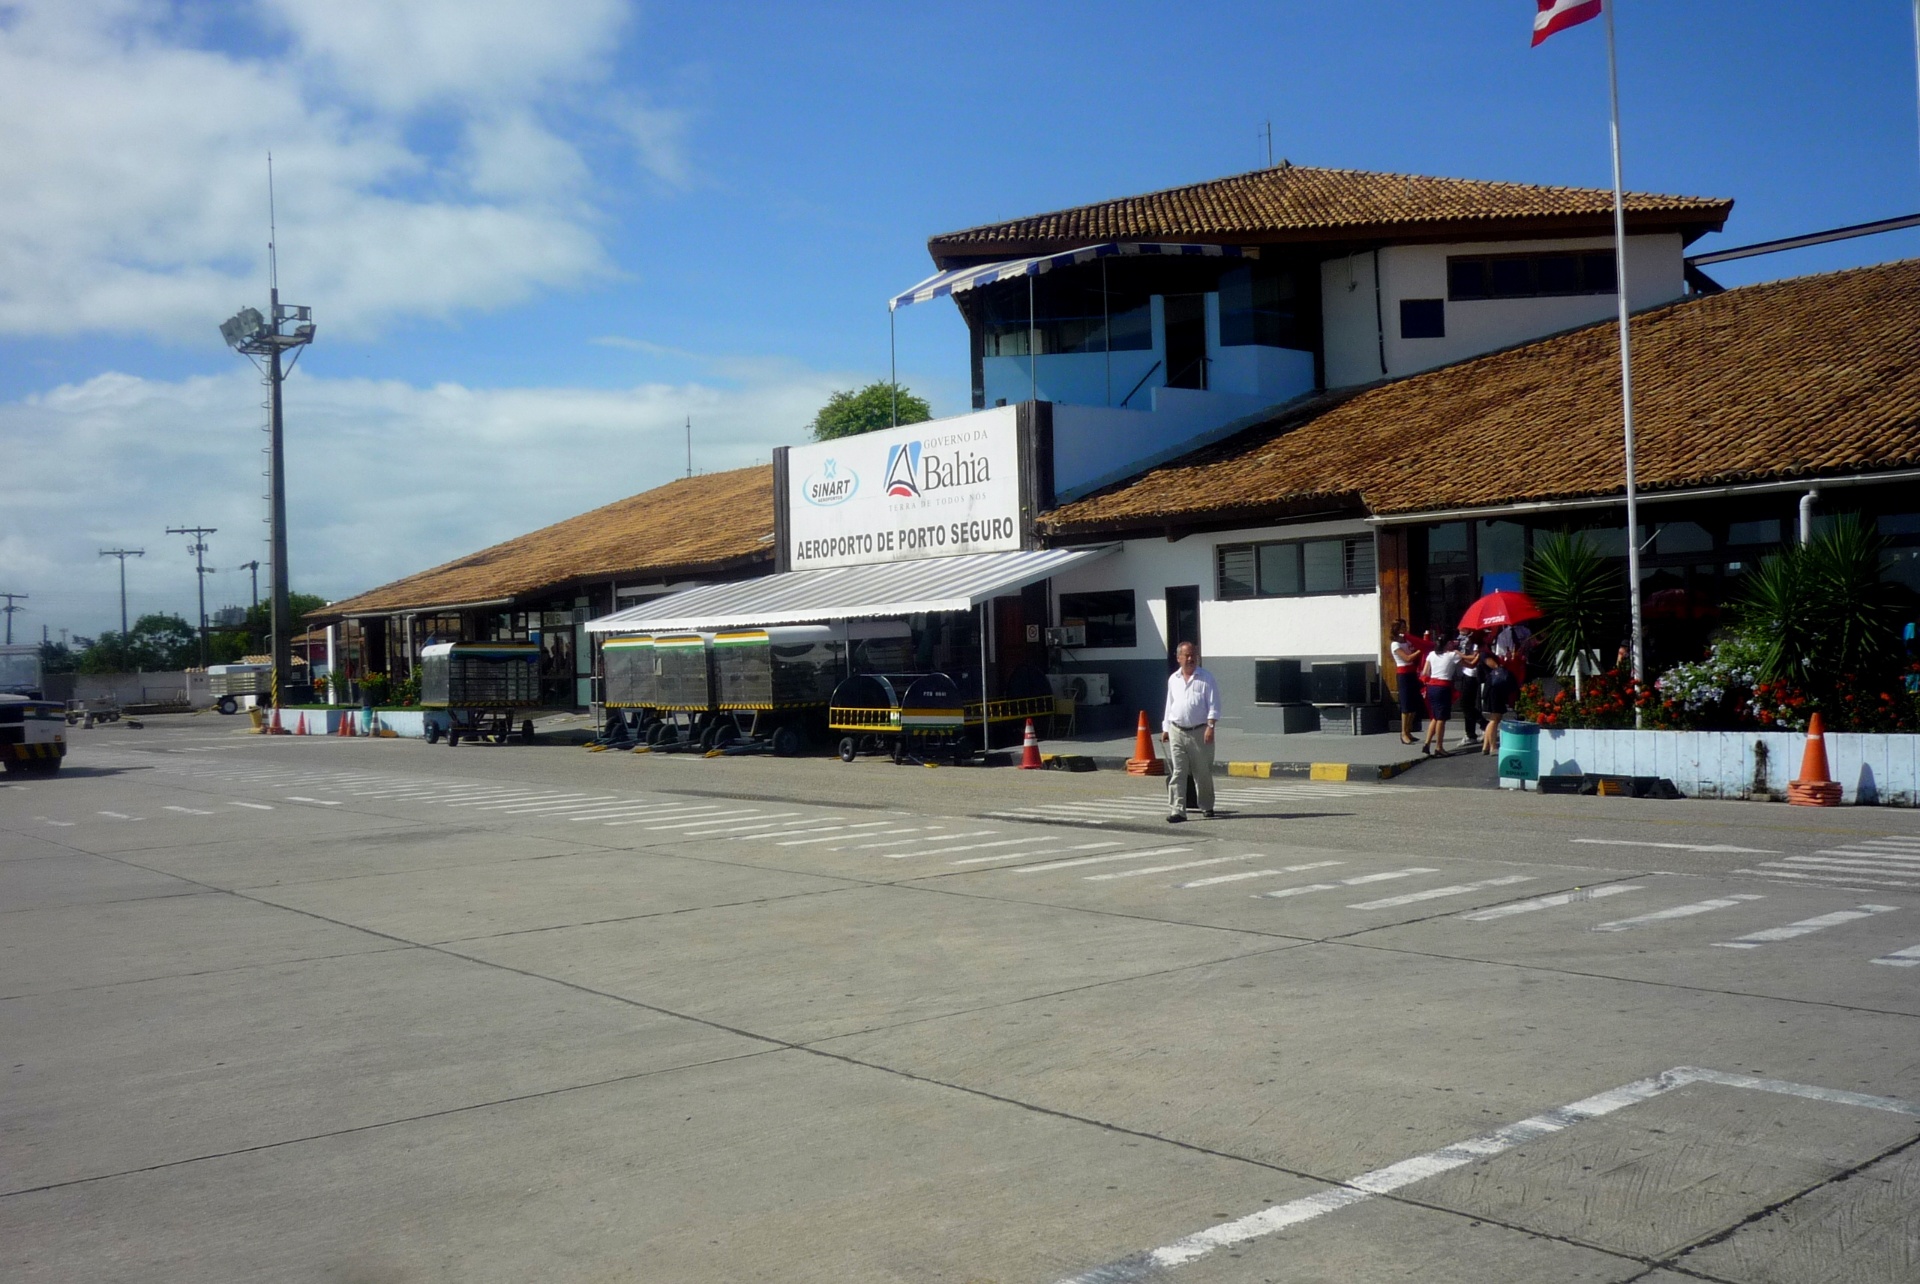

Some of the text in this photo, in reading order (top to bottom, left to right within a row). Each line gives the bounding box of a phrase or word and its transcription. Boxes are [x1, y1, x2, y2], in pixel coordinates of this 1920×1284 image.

[923, 429, 988, 449] GOVERNO DA
[923, 451, 991, 490] Bahia
[812, 480, 851, 499] SINART
[889, 502, 917, 512] TERRA
[920, 499, 932, 508] DE
[936, 496, 965, 506] TODOS
[797, 516, 1013, 561] AEROPORTO DE PORTO SEGURO
